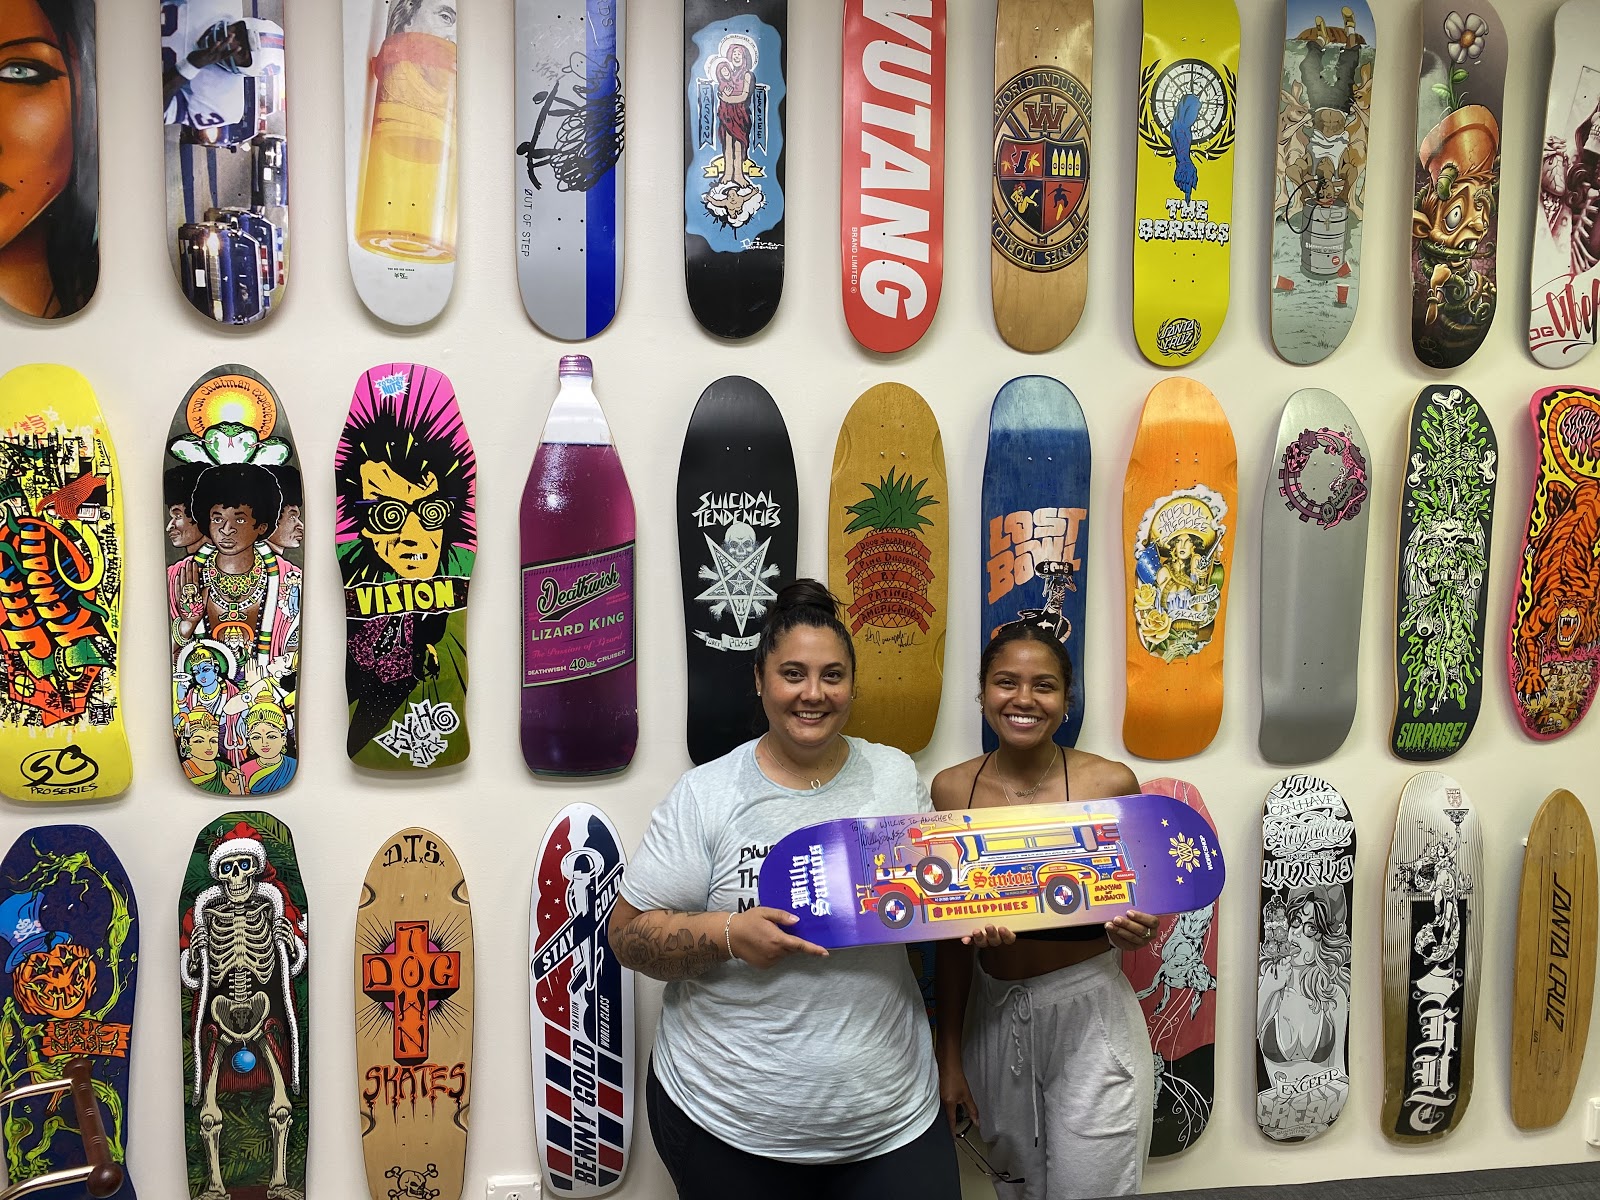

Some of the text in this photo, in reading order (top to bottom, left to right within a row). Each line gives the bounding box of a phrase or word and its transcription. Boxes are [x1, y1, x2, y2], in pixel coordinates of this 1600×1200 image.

[994, 75, 1035, 116] WORLD
[1037, 73, 1092, 117] INDUSTRI
[523, 214, 532, 228] OF
[1165, 199, 1208, 221] THE
[521, 231, 531, 257] STEP
[692, 508, 781, 528] TENDENCIES
[697, 490, 781, 511] SUICIDAL
[989, 507, 1088, 558] LOST
[20, 526, 100, 648] KENDALL
[537, 562, 620, 615] Deathwish
[881, 571, 898, 581] BY
[986, 536, 1082, 606] BOWL
[356, 580, 455, 616] VISION
[861, 602, 921, 620] AMERICANOS
[0, 577, 51, 659] JEFF
[531, 611, 625, 641] LIZARD KING
[527, 665, 566, 676] DEATHWISH
[597, 649, 626, 663] CRUISER
[378, 703, 457, 754] PSYCHO
[1396, 722, 1467, 750] SURPRISE!
[31, 783, 98, 795] PRO SERIES
[1199, 835, 1213, 871] WORKSHOP
[738, 869, 760, 889] Th
[807, 844, 833, 916] Santos
[972, 866, 1035, 888] Santos
[542, 874, 621, 971] STAY GOLD
[945, 900, 1029, 916] PHILIPPINES
[1544, 871, 1573, 1034] SANTA CRUZ
[600, 995, 610, 1049] WORLD CLASS
[51, 1030, 120, 1055] NASH
[362, 1063, 467, 1107] SKATES
[573, 1039, 597, 1186] BENNY GOLD
